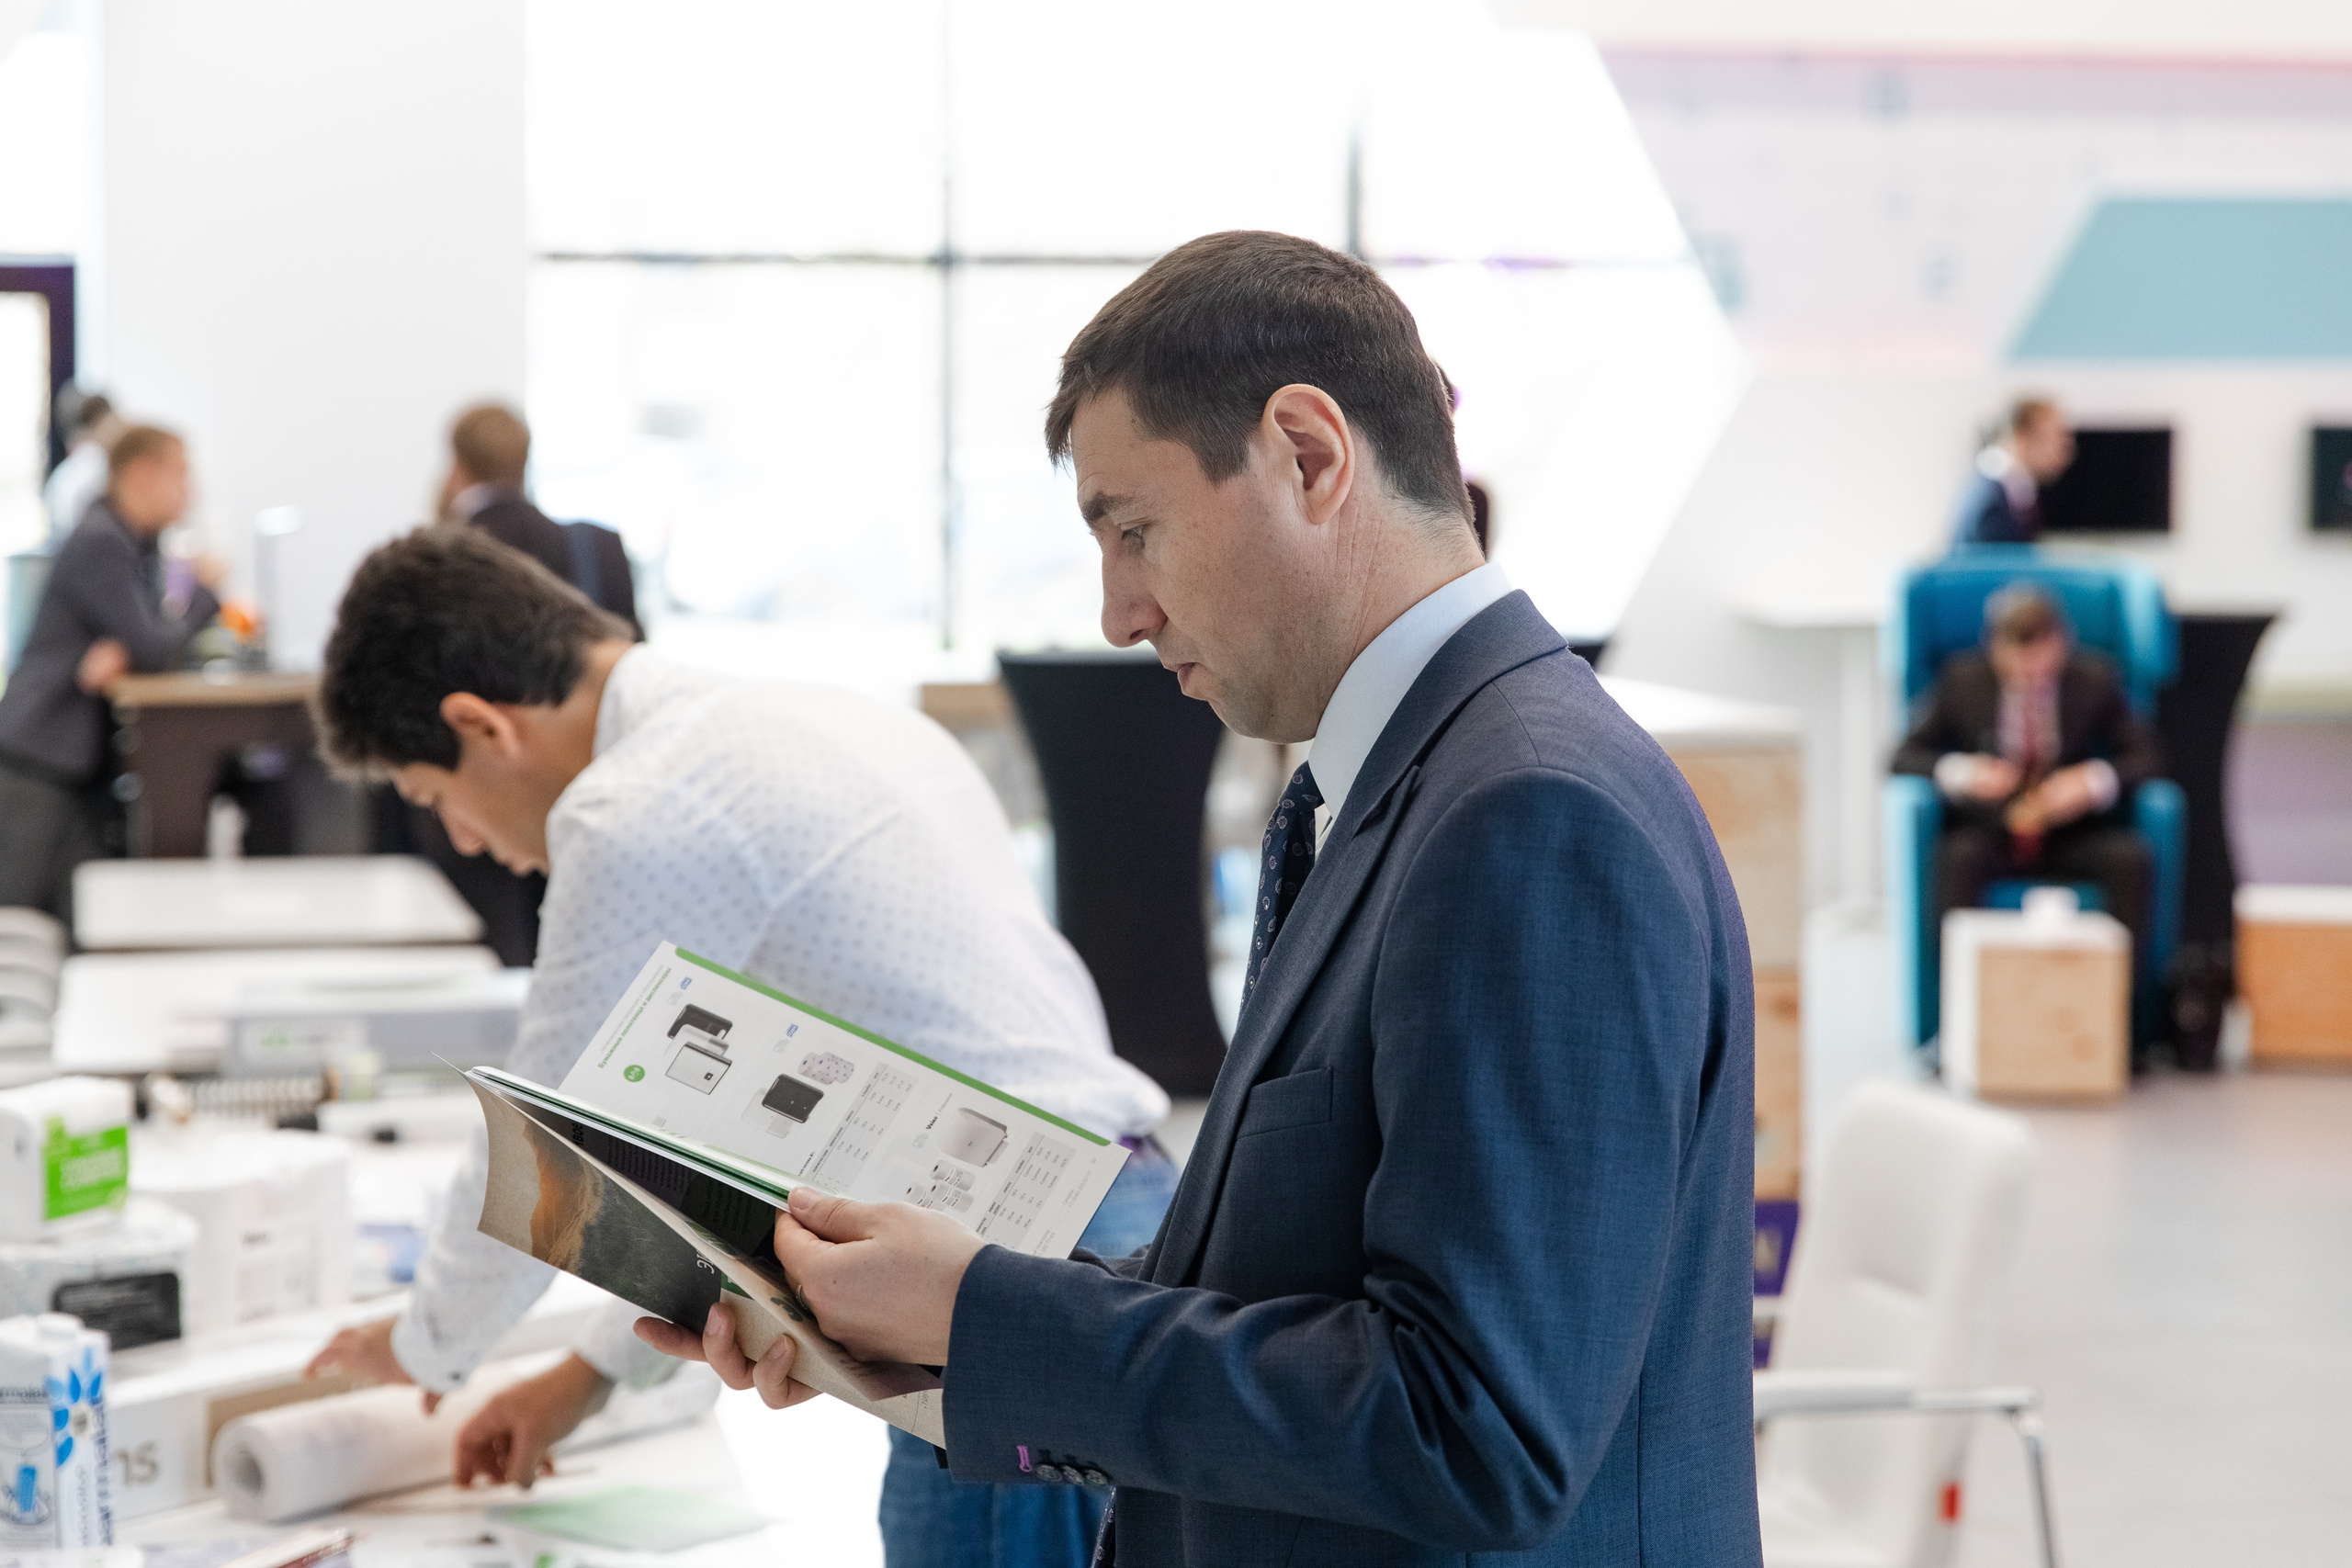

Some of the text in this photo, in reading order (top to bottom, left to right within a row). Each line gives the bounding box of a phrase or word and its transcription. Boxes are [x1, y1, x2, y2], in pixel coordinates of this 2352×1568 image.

[597, 1036, 623, 1067] Бумажные
[620, 1006, 643, 1036] полотенца
[644, 966, 672, 1001] диспенсеры
